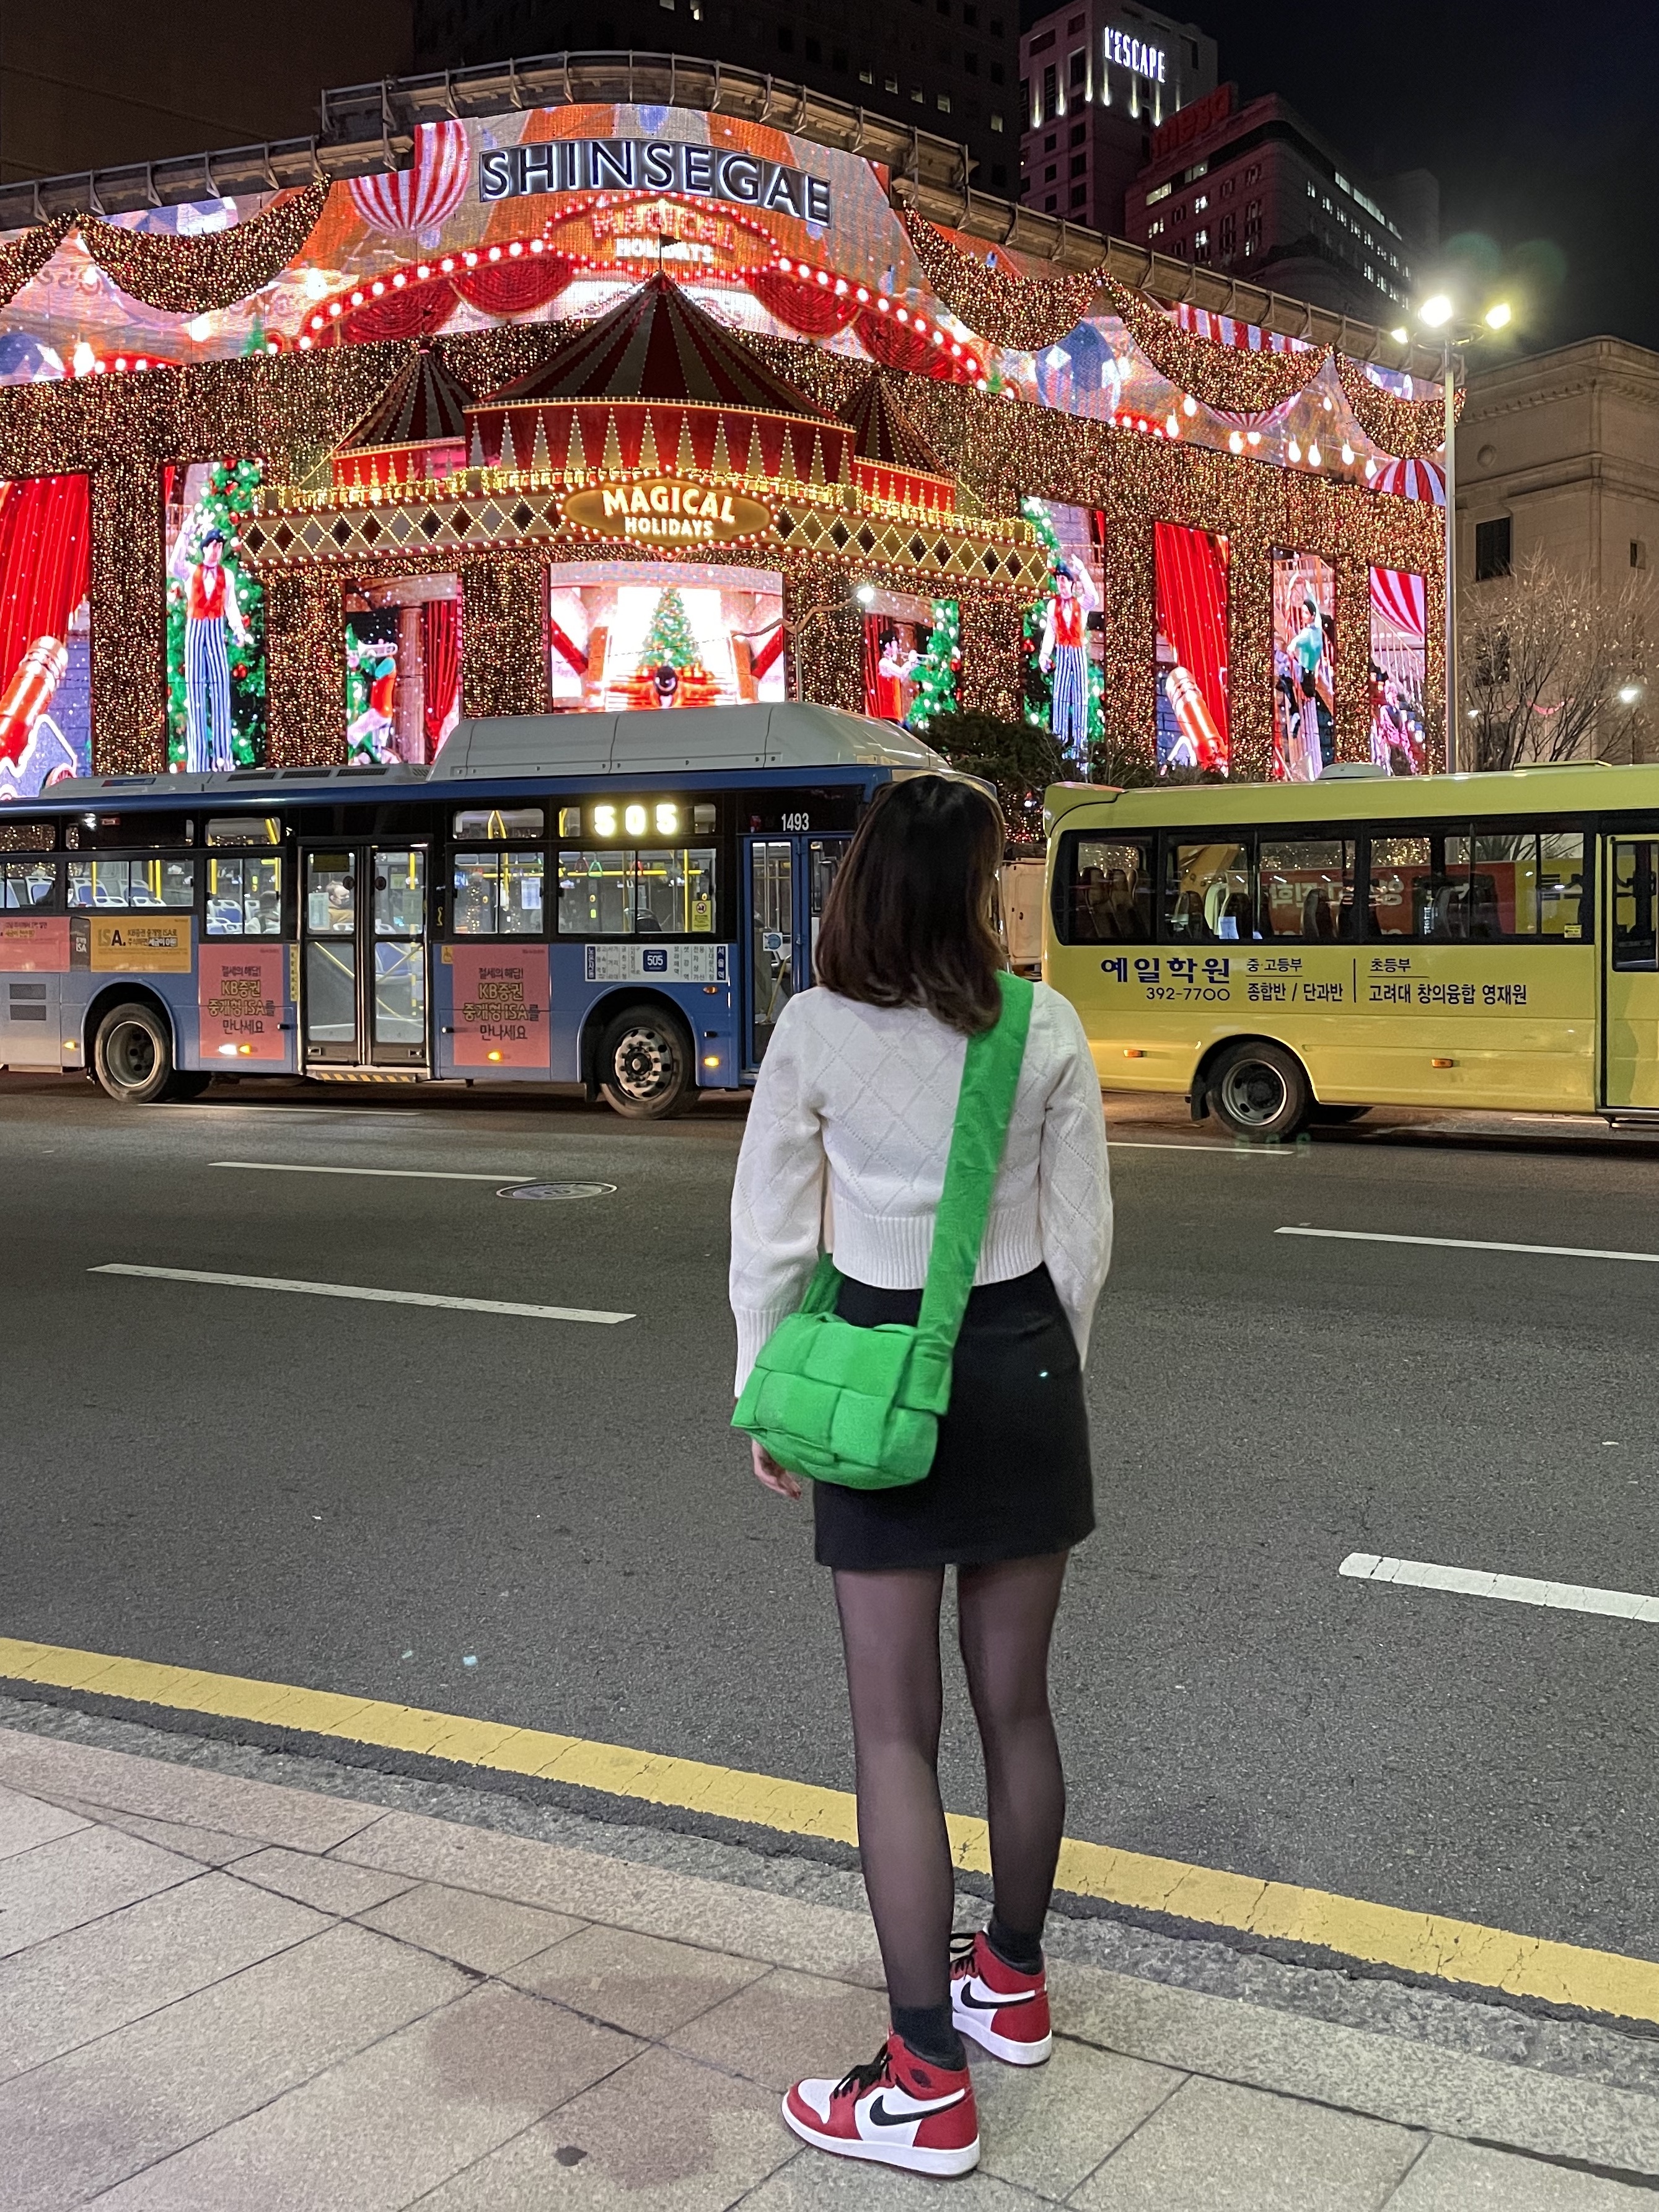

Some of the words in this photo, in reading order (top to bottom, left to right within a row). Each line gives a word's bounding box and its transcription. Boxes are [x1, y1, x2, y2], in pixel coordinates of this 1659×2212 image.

[1104, 27, 1166, 83] L'ESCAPE
[483, 141, 830, 226] SHINSEGAE
[601, 485, 736, 523] MAGICAL
[625, 518, 714, 538] HOLIDAYS
[593, 804, 677, 836] 505
[781, 813, 809, 831] 1493
[647, 955, 663, 966] 505
[1370, 958, 1411, 973] 초등부
[1101, 958, 1230, 984] 예일학원
[221, 979, 261, 998] KB증권
[478, 982, 524, 1002] KB증권
[1146, 987, 1230, 1002] 392-7700
[1247, 982, 1286, 1002] 종합반
[1303, 983, 1344, 1002] 단과반
[1369, 984, 1411, 1003] 고려대
[1417, 984, 1476, 1005] 창의융합
[1482, 984, 1527, 1005] 영재원
[208, 998, 242, 1017] 중개형
[463, 1002, 501, 1021] 중개형
[222, 1020, 265, 1035] 만나세요
[480, 1024, 527, 1041] 만나세요
